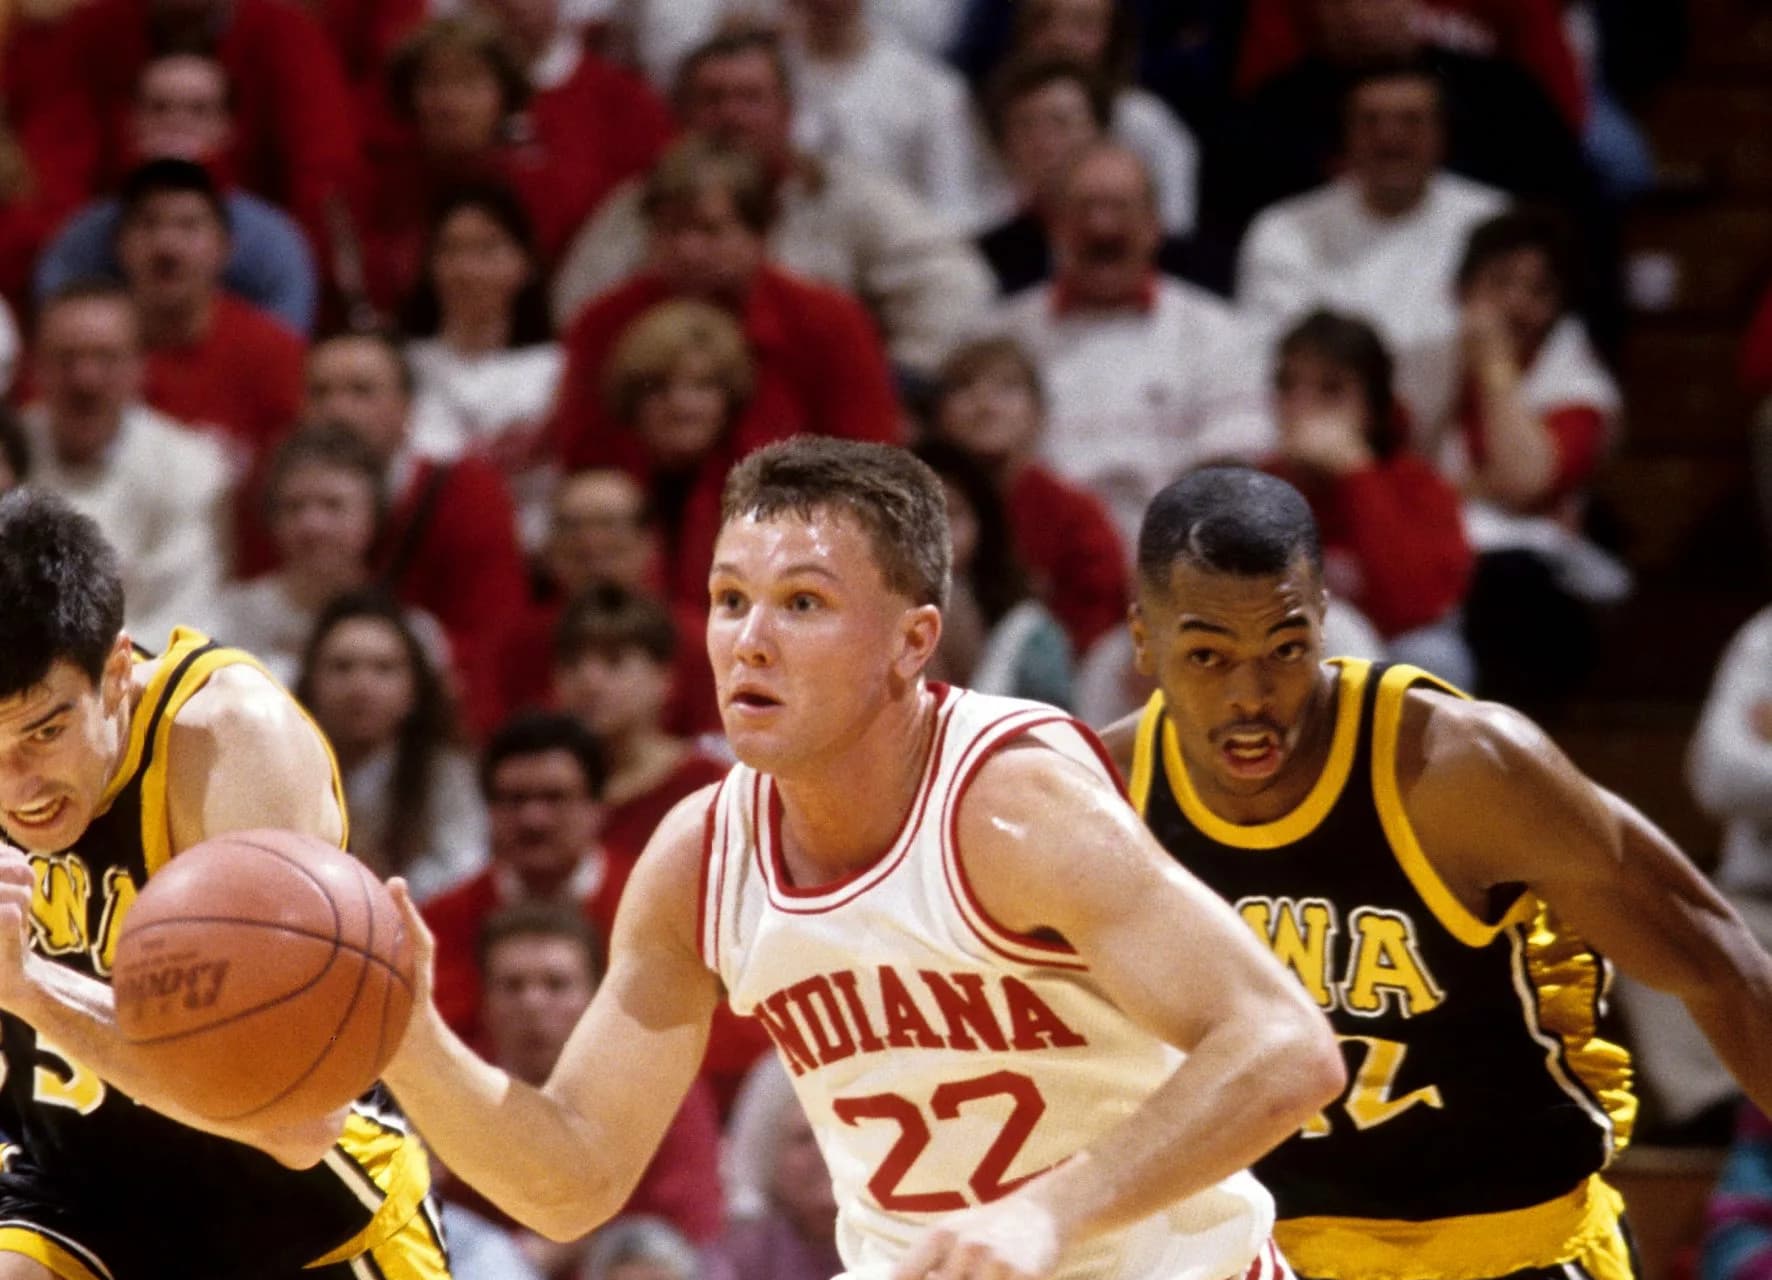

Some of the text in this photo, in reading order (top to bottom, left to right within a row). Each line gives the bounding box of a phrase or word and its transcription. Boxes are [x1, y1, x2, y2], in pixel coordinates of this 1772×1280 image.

[1235, 896, 1447, 1019] WA
[753, 965, 1089, 1077] NDIANA
[832, 1070, 1073, 1213] 22
[1301, 1034, 1444, 1139] 2
